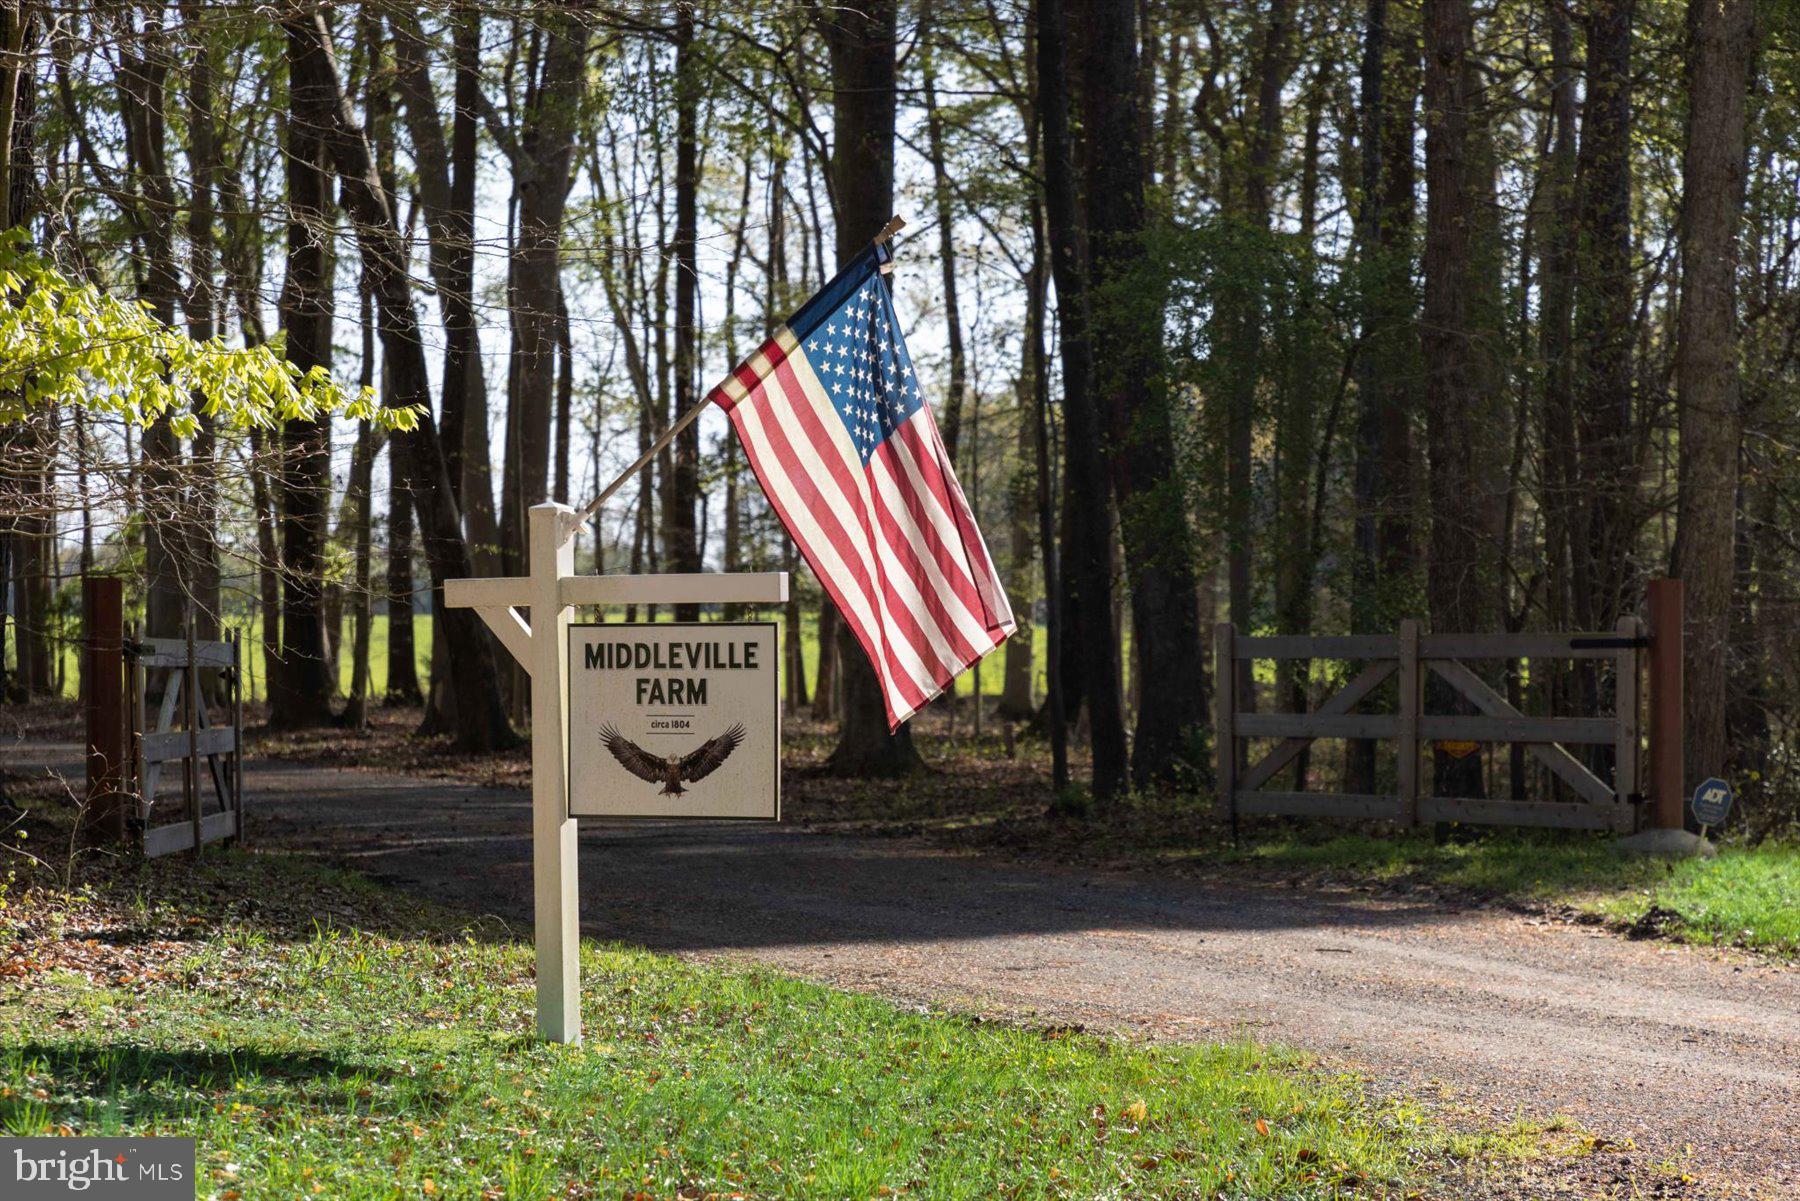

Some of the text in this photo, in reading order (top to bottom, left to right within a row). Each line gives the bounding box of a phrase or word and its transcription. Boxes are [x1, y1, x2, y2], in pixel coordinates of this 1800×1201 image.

[585, 642, 759, 670] MIDDLEVILLE
[636, 678, 707, 705] FARM
[651, 720, 690, 729] circa 1804
